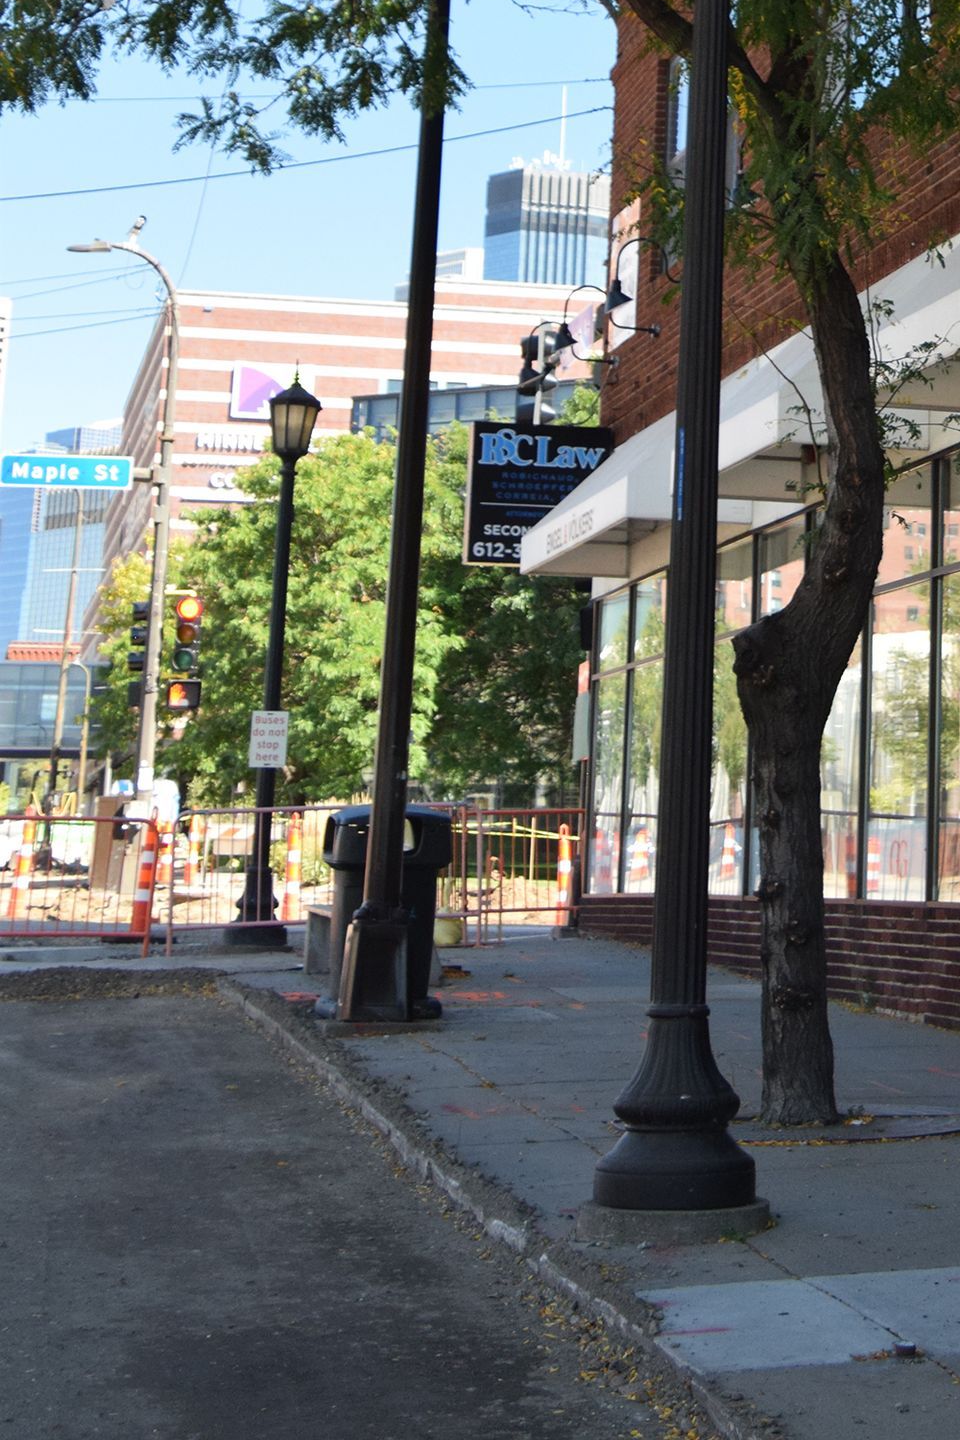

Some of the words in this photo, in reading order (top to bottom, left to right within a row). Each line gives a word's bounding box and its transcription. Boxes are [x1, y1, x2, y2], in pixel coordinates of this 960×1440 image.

[533, 435, 605, 470] Law
[11, 461, 80, 483] Maple
[94, 464, 120, 482] St
[255, 715, 285, 724] Buses
[252, 728, 265, 736] do
[257, 741, 279, 750] stop
[255, 753, 280, 761] here
